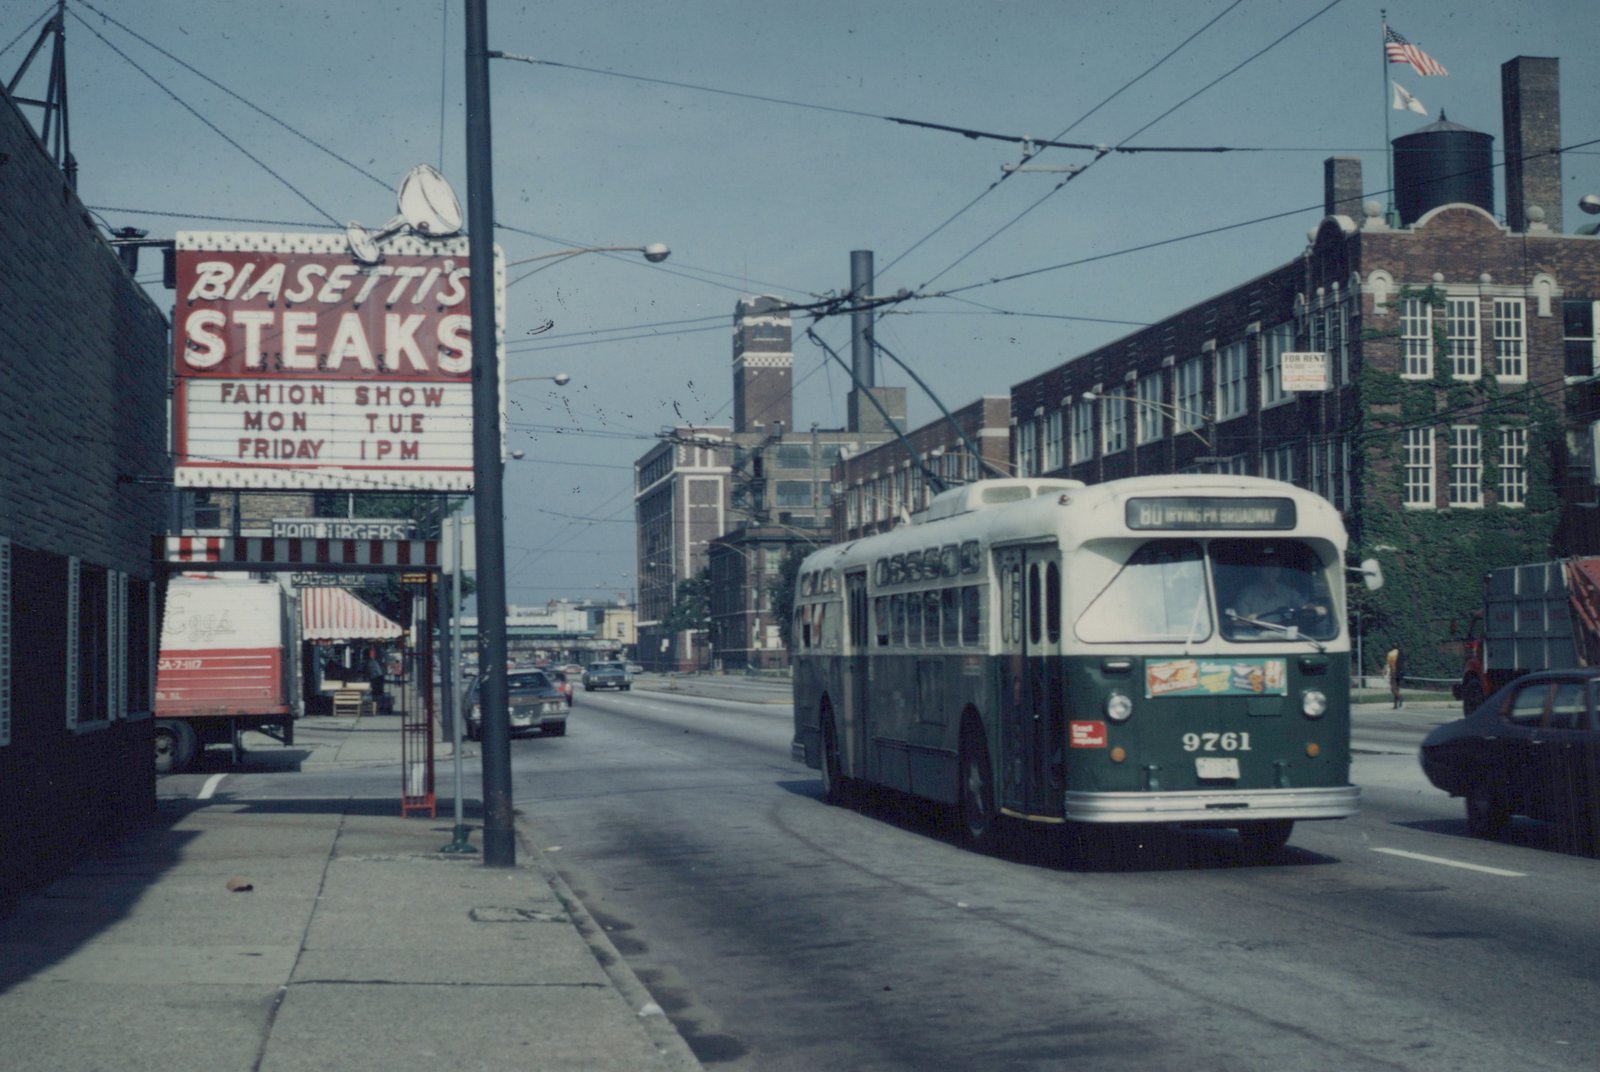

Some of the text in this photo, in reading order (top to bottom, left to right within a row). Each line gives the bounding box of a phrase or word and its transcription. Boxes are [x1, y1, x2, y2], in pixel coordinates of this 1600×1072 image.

[187, 259, 470, 306] BIASETTI'S
[183, 309, 472, 374] STEAKS
[220, 383, 444, 407] FAHION SHOW
[243, 411, 425, 434] MON TUE
[237, 438, 325, 460] FRIDAY
[1182, 731, 1253, 752] 9761
